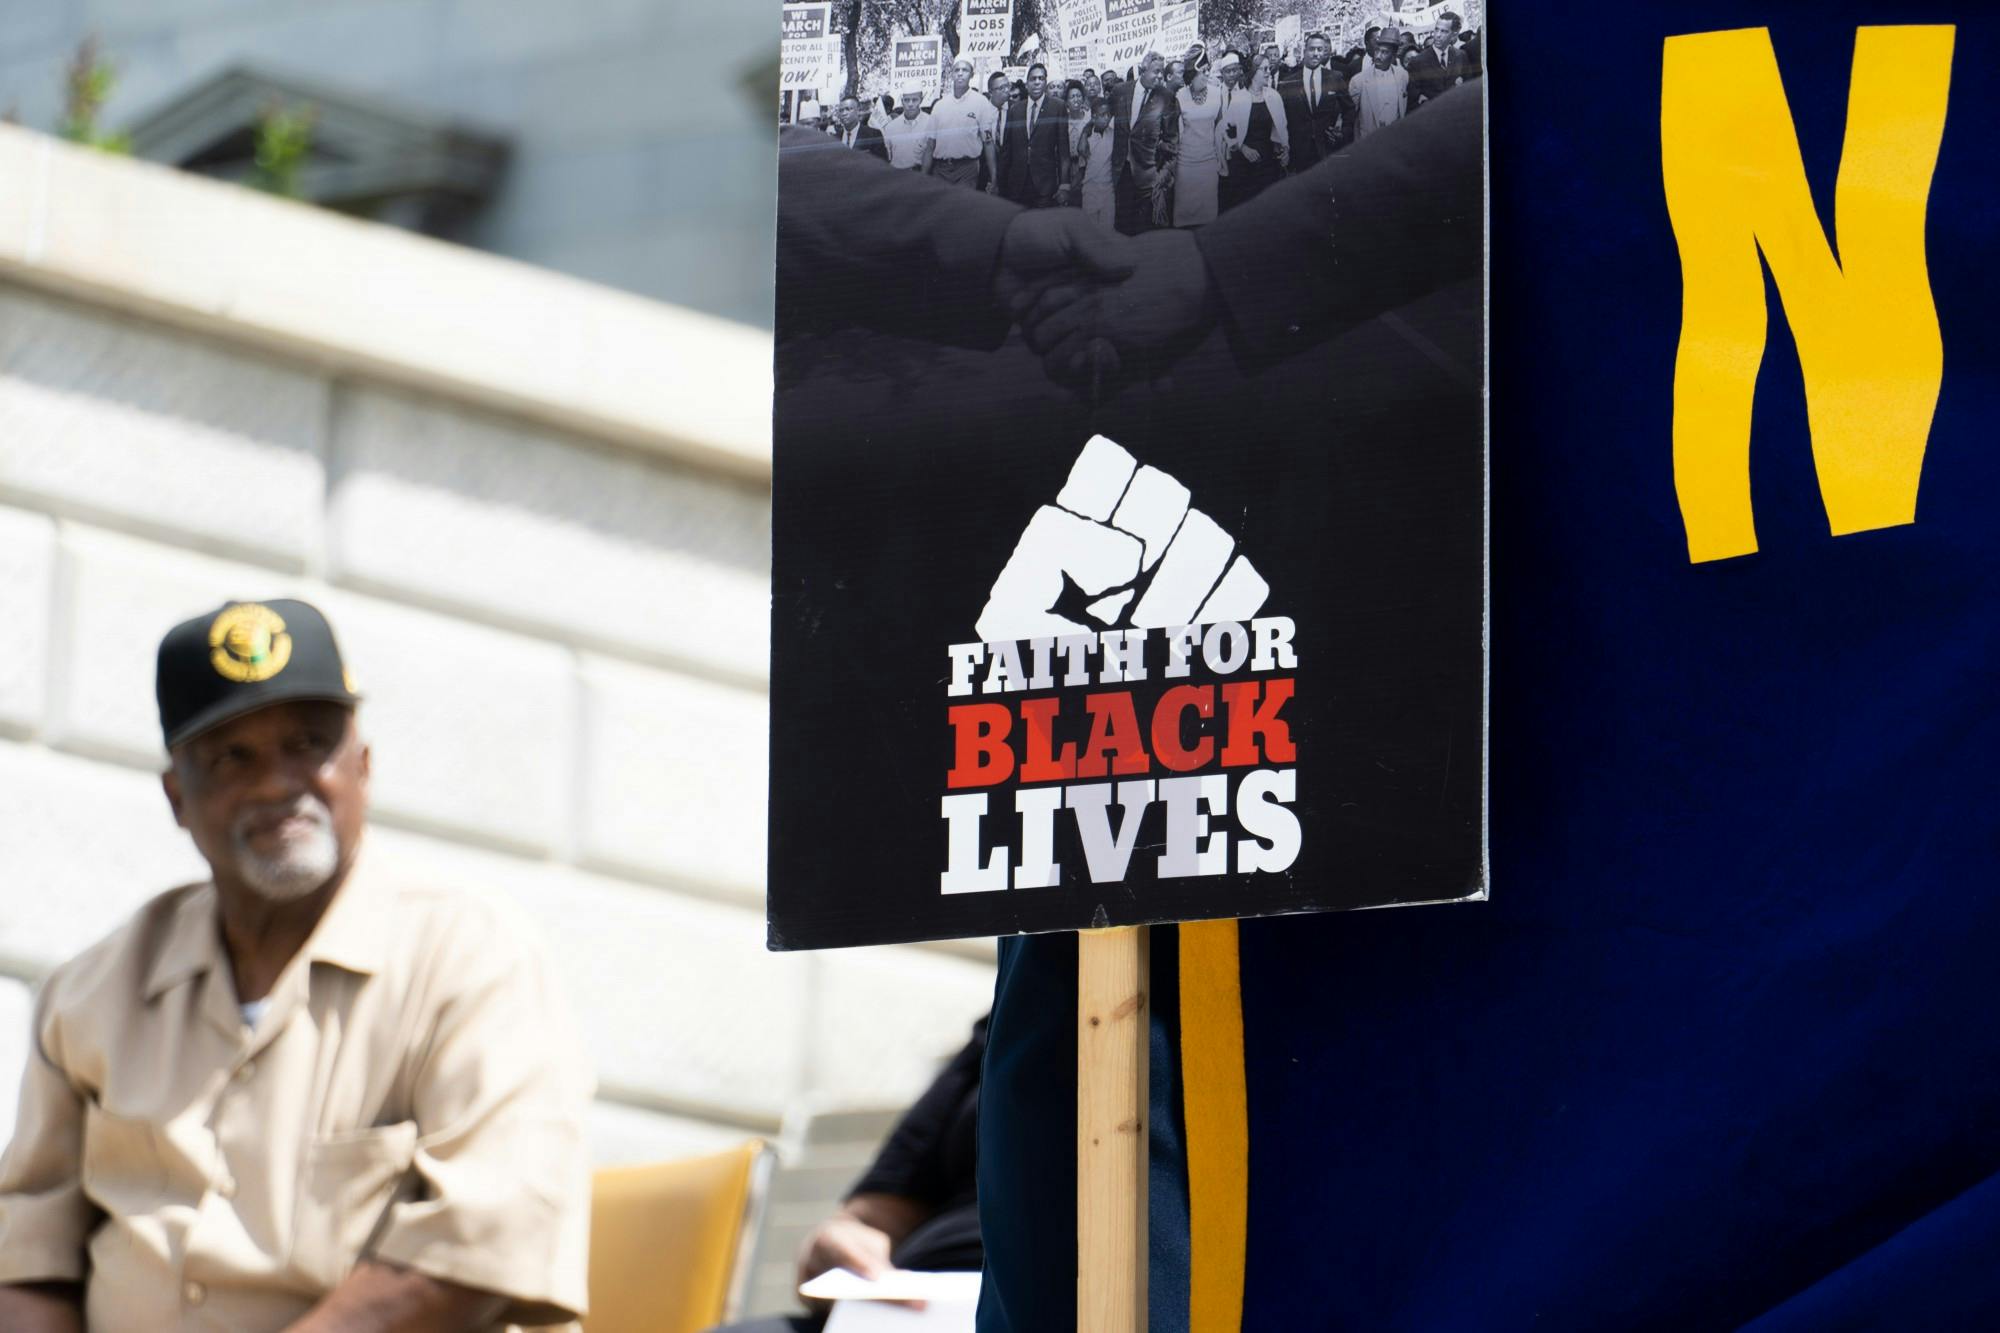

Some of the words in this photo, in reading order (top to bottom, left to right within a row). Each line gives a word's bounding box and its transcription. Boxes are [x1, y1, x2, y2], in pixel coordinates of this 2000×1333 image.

[791, 11, 808, 20] WE
[969, 18, 1005, 30] JOBS
[1107, 20, 1129, 34] FIRST
[1131, 13, 1156, 28] CLASS
[1106, 24, 1158, 45] CITIZENSHIP
[967, 39, 1006, 52] NOW!
[898, 49, 936, 61] MARCH
[894, 67, 938, 79] INTEGRATED
[894, 79, 937, 90] SCOLS
[1661, 24, 1956, 564] N
[947, 631, 1148, 697] FAITH
[1164, 616, 1298, 679] FOR
[947, 678, 1297, 789] BLACK
[940, 769, 1302, 895] LIVES
